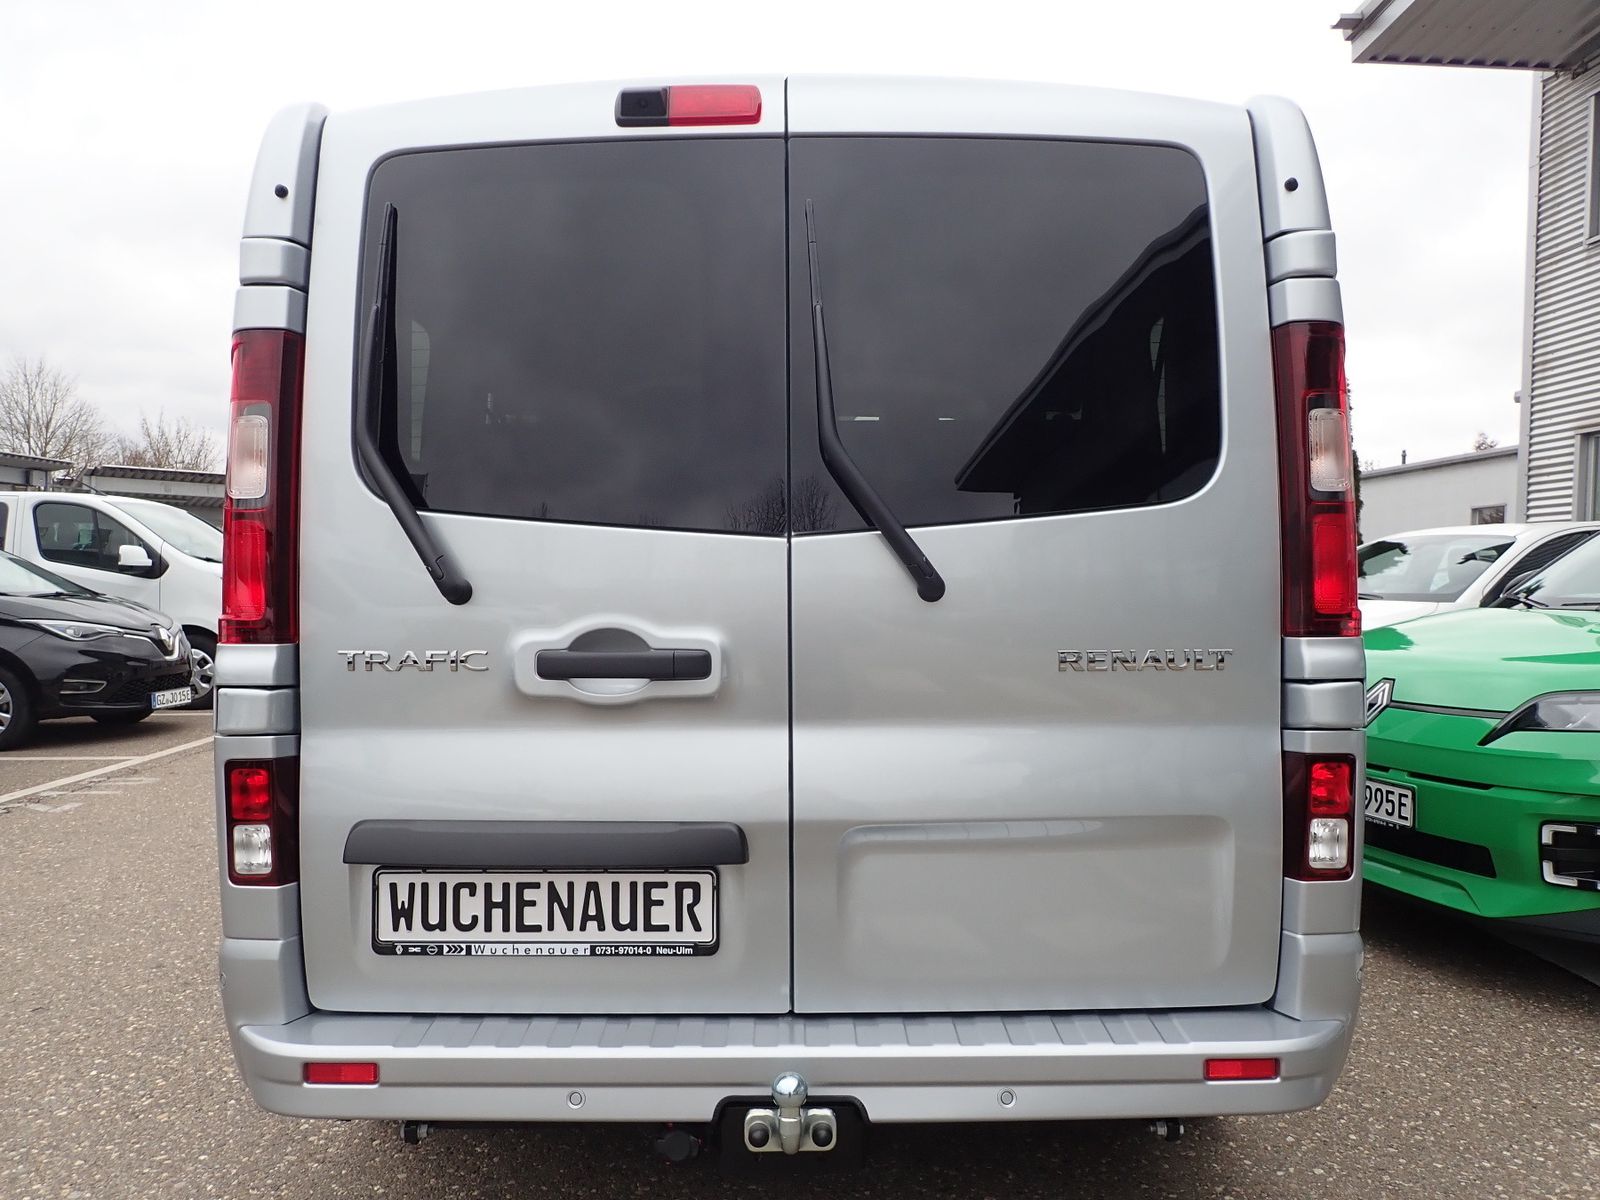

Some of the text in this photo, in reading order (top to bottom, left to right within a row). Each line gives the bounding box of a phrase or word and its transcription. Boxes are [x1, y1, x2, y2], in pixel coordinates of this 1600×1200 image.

[337, 649, 489, 672] TRAFIC
[1057, 648, 1233, 672] RENAULT
[389, 881, 702, 933] WUCHENAUER
[473, 944, 693, 955] Wuchenauer 0731-97014-0 Neu-Ulm
